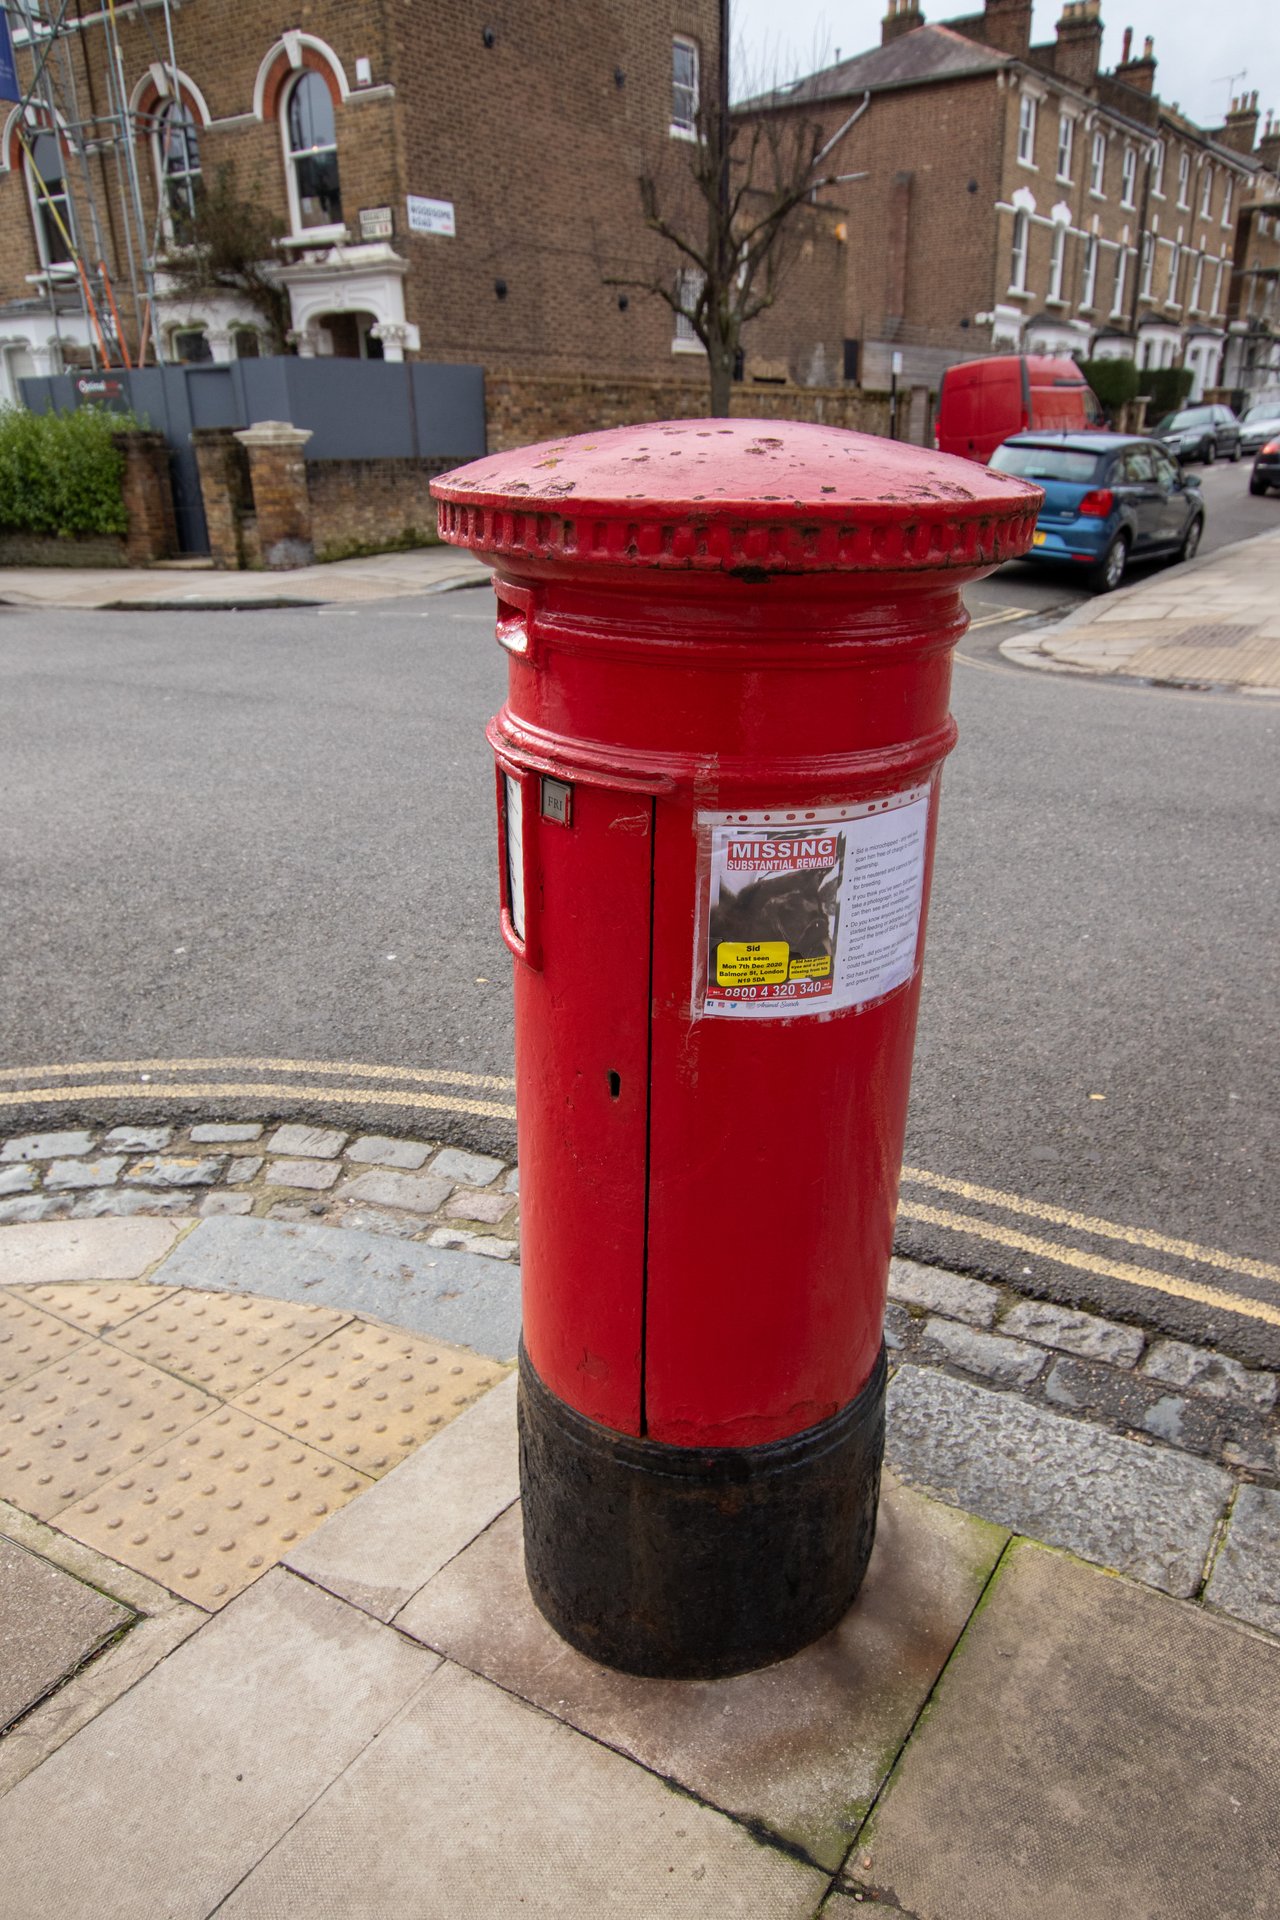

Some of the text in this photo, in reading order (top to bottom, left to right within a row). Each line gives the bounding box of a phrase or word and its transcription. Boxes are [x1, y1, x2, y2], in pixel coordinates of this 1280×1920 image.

[547, 796, 563, 812] FRI
[732, 840, 832, 858] MISSING
[728, 856, 834, 870] SUBSTANTIAL REWARD
[867, 870, 887, 878] neutered
[849, 935, 865, 943] around
[725, 987, 757, 997] 0800
[760, 986, 768, 996] 4
[773, 984, 796, 996] 320
[800, 982, 821, 994] 340
